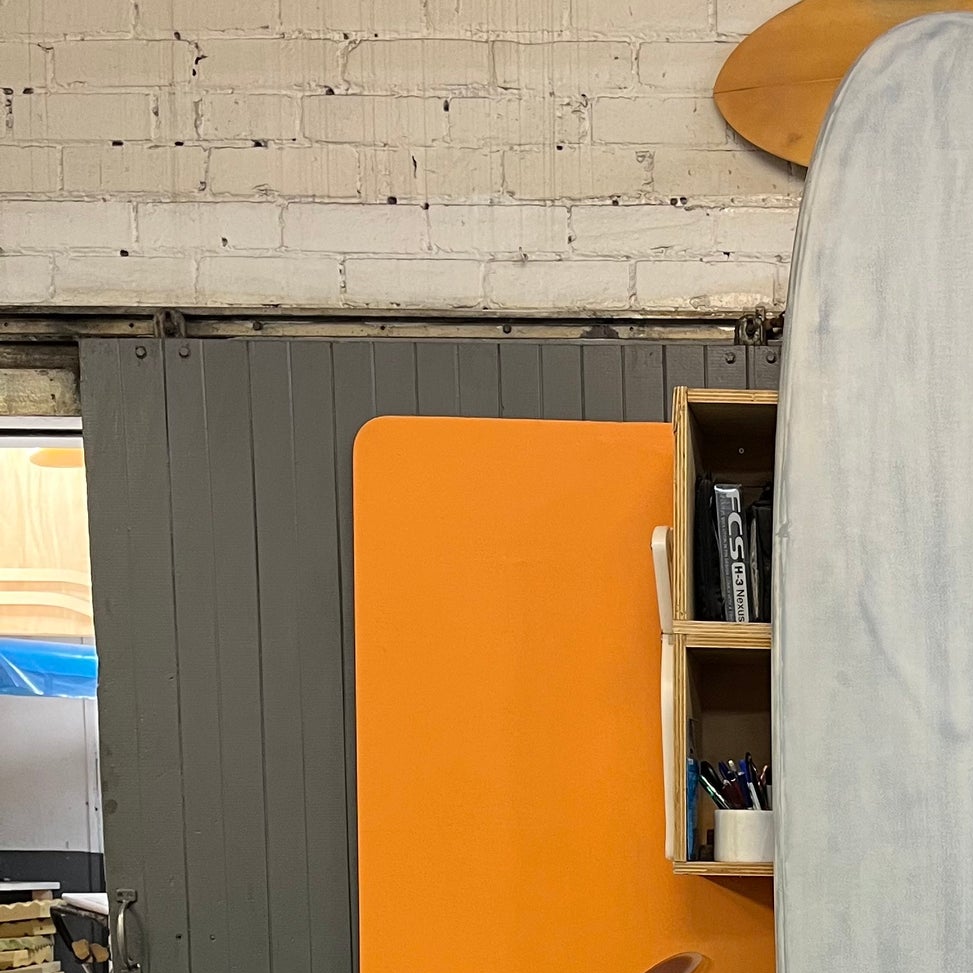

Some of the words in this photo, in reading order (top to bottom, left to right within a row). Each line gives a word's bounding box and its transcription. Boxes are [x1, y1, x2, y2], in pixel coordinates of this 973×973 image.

[726, 489, 744, 560] FCS
[734, 566, 744, 586] H-3
[736, 589, 745, 622] Nexus
